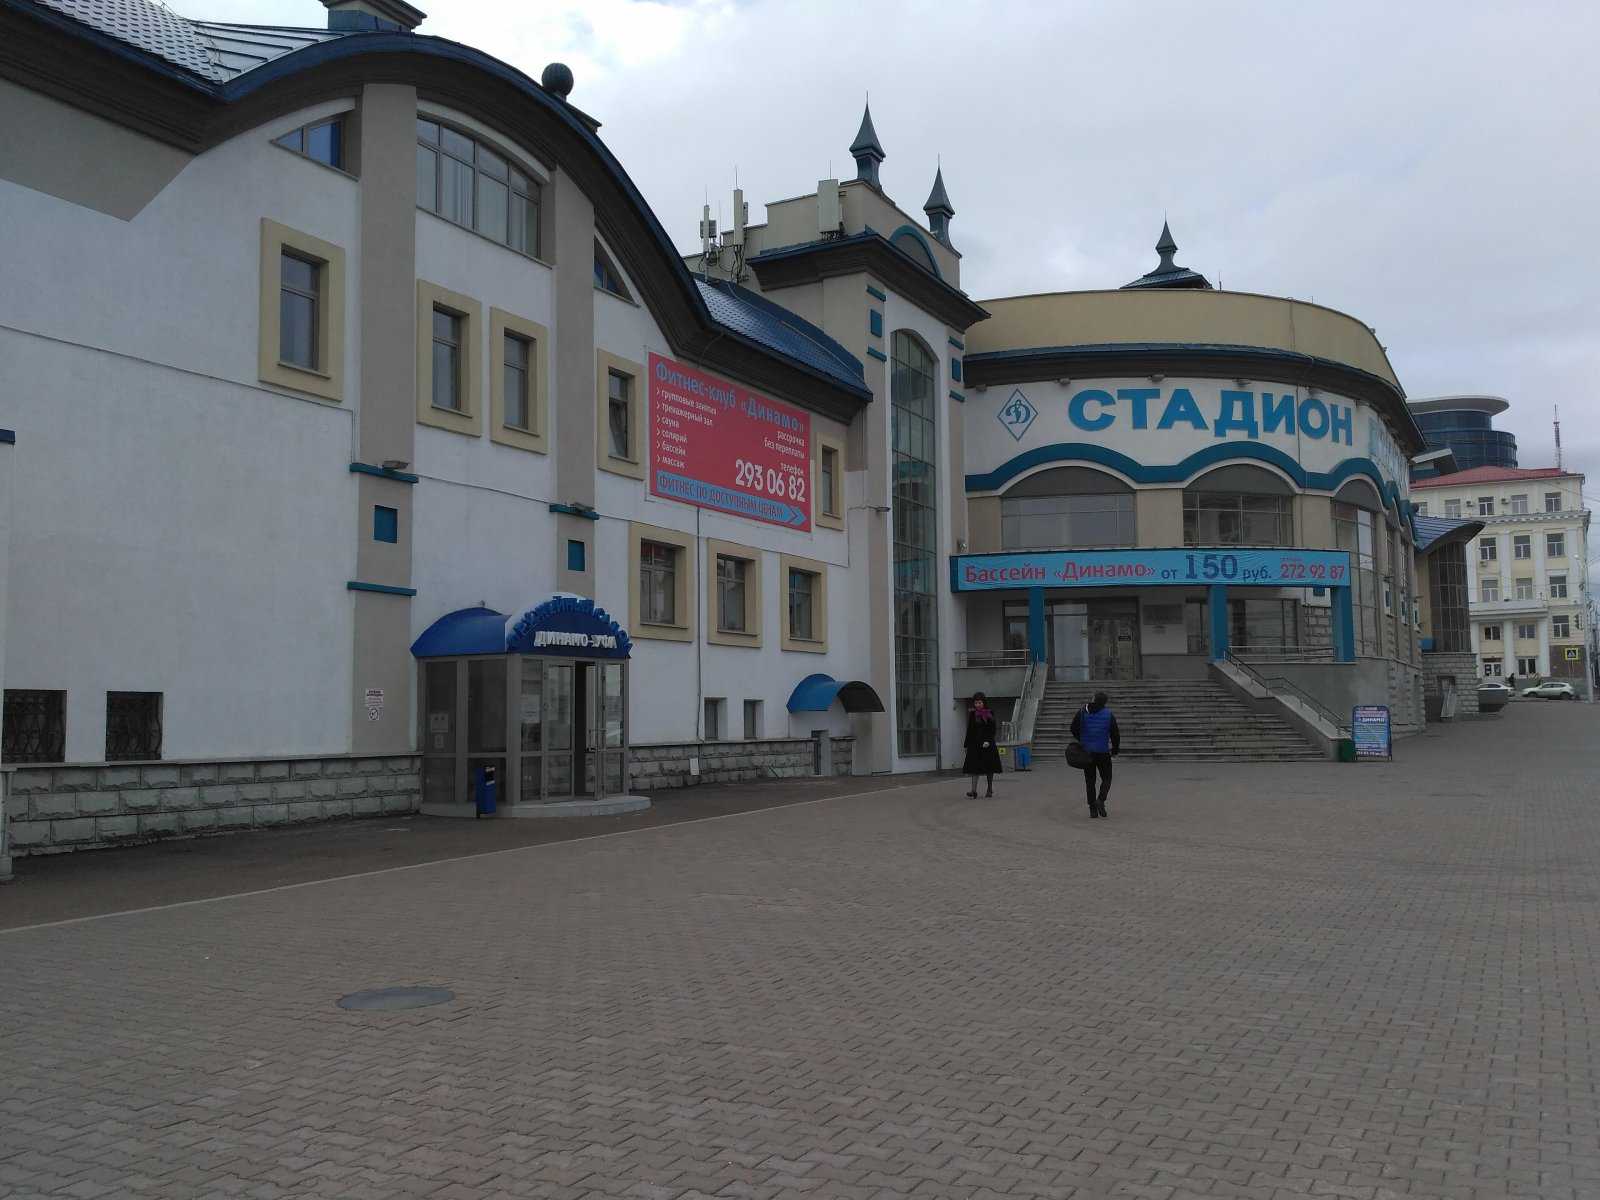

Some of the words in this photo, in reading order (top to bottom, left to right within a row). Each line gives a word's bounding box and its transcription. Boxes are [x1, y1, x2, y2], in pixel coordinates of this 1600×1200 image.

[656, 362, 736, 409] Фитнес-клуб
[661, 417, 680, 428] сауна
[1068, 388, 1353, 446] СТАДИОН
[735, 458, 764, 491] 293
[766, 468, 785, 497] 06
[788, 475, 806, 502] 82
[965, 562, 1046, 583] Бассейн
[1055, 560, 1155, 581] «Динамо»
[1161, 569, 1178, 580] от
[1185, 554, 1238, 580] 150
[1243, 565, 1272, 582] руб.
[1280, 563, 1306, 579] 272
[1309, 563, 1326, 579] 92
[1330, 564, 1345, 580] 87
